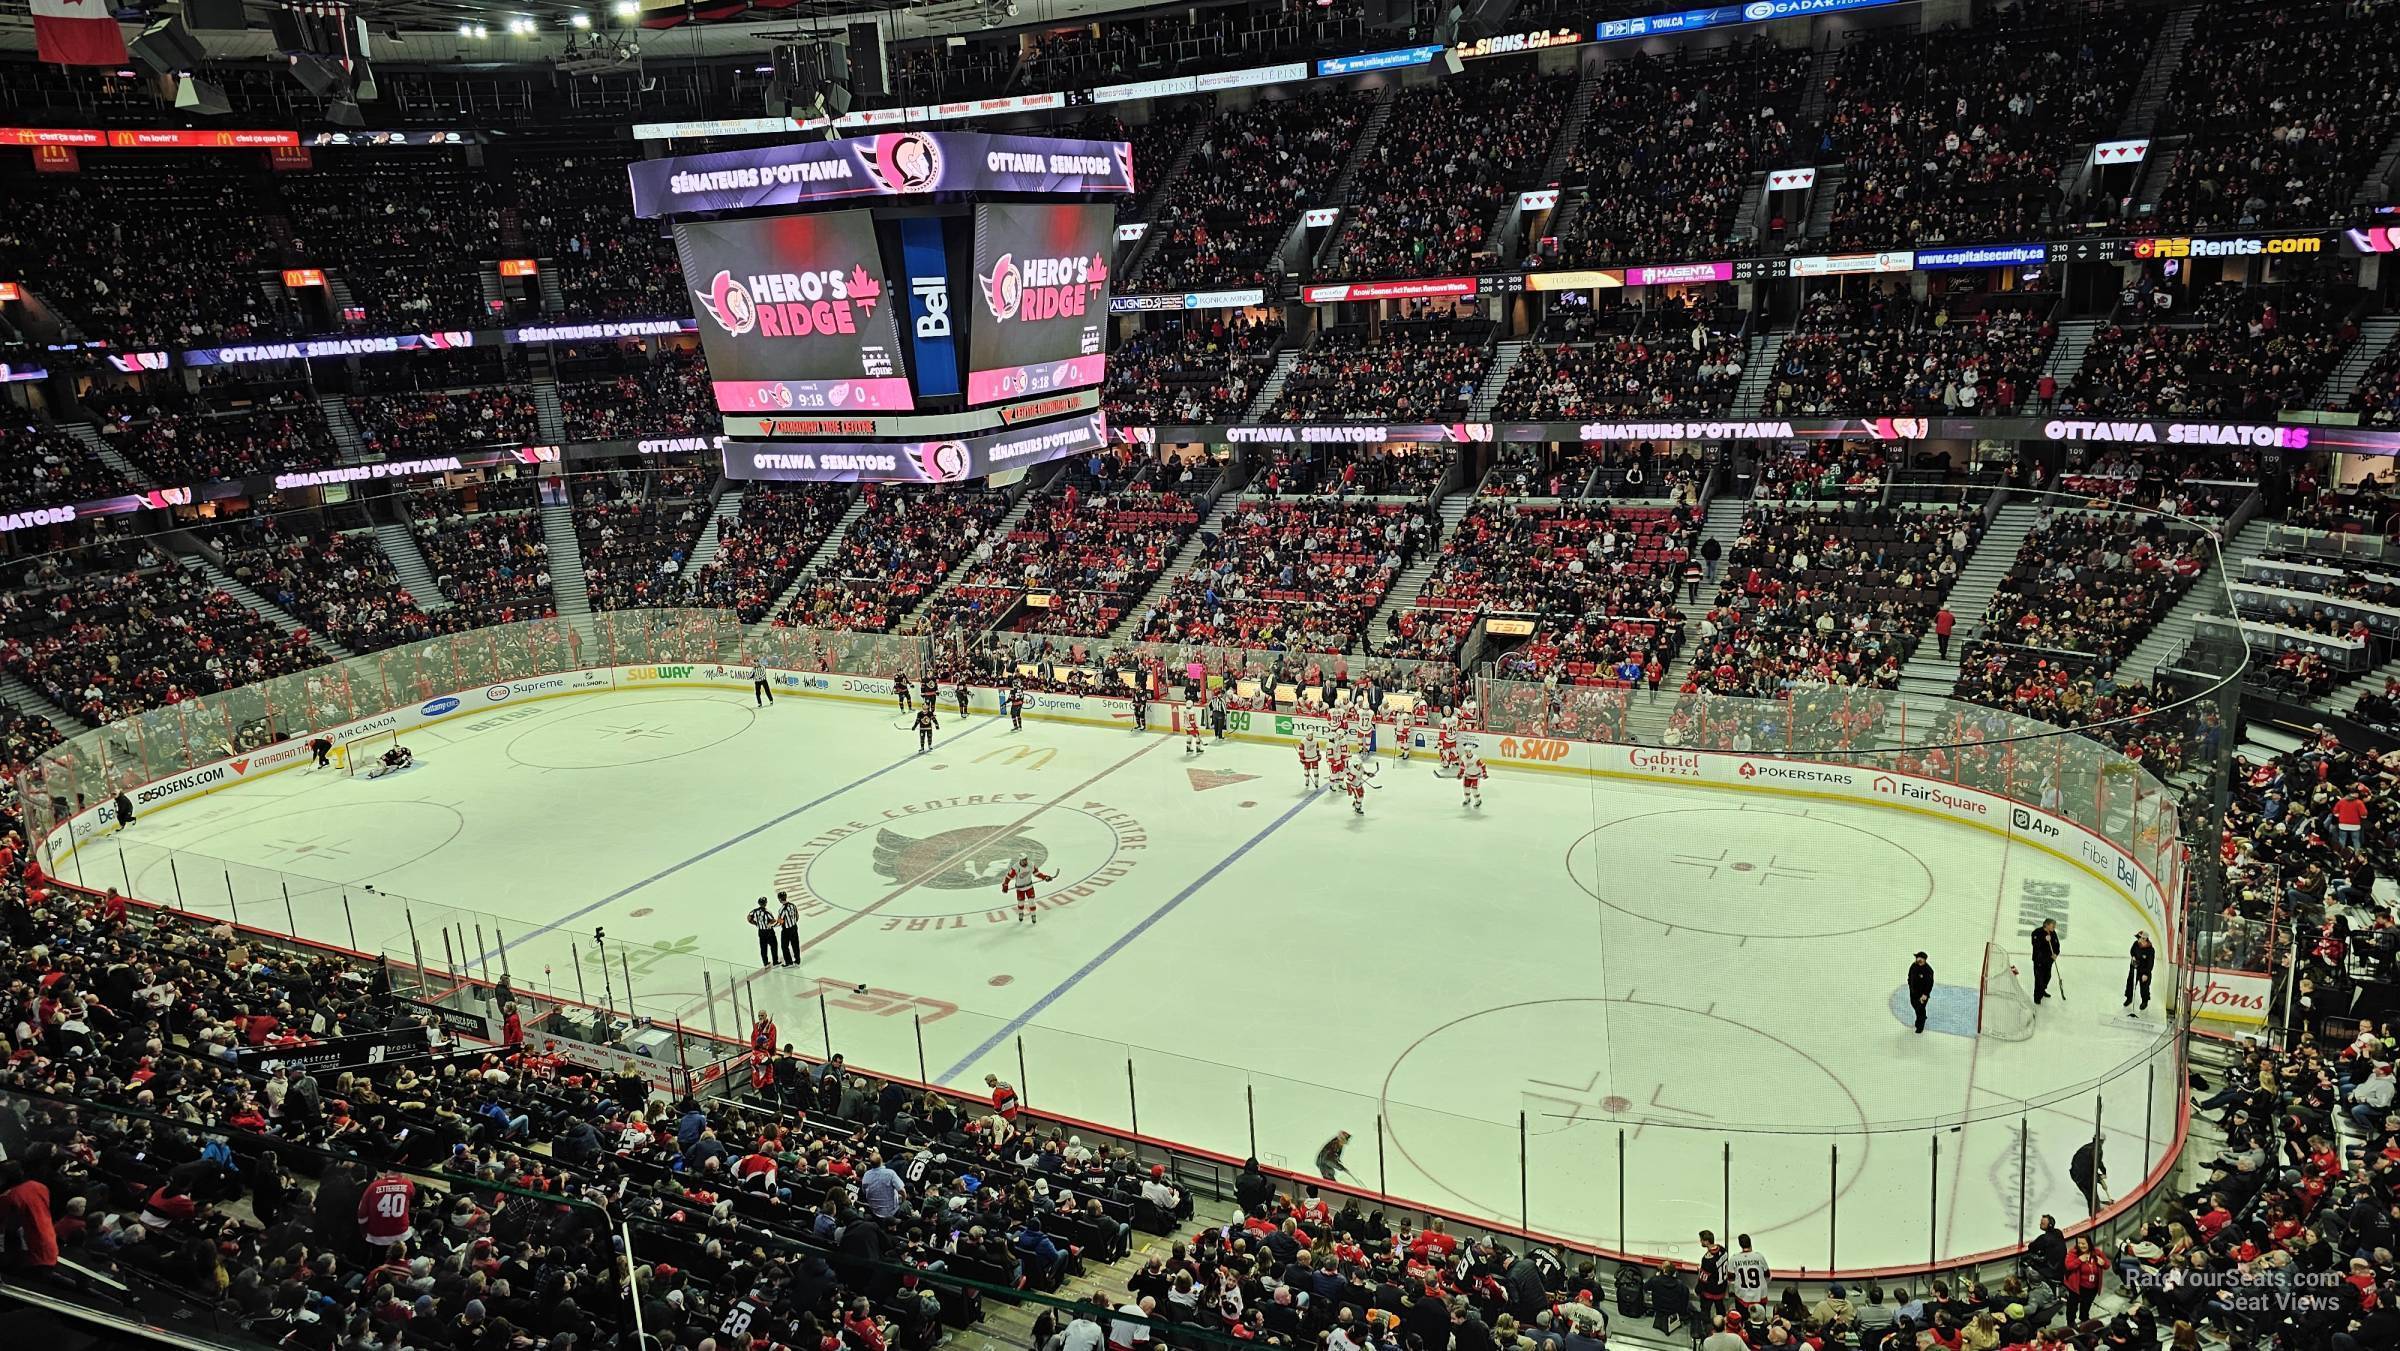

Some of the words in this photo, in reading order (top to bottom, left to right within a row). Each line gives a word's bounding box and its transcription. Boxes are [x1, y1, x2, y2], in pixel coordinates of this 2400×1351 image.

[1652, 17, 1684, 28] YOW.CA
[1475, 31, 1551, 55] SIGNS.CA
[987, 152, 1046, 173] OTTAWA
[1049, 155, 1111, 176] SENATORS
[670, 169, 758, 194] SÉNATEURS
[760, 159, 853, 189] D'OTTAWA
[2051, 254, 2067, 262] 210
[2099, 251, 2114, 260] 211
[2052, 244, 2068, 253] 310
[2099, 242, 2114, 251] 311
[1737, 262, 1752, 270] 309
[1771, 261, 1786, 269] 310
[1919, 248, 2045, 266] www.capitalsecurity.ca
[1022, 255, 1087, 287] HERO'S
[1657, 265, 1716, 278] MAGENTA
[1736, 271, 1751, 279] 209
[1771, 270, 1786, 278] 210
[749, 270, 848, 303] HERO'S
[1353, 289, 1370, 297] Know
[1393, 286, 1403, 294] Act
[1423, 283, 1447, 293] Remove
[1479, 278, 1493, 286] 308
[1508, 276, 1522, 284] 309
[1479, 286, 1493, 294] 208
[1508, 285, 1522, 293] 209
[911, 276, 951, 338] Bell
[1021, 284, 1085, 322] RIDGE
[1200, 297, 1229, 305] KONICA
[1230, 294, 1264, 304] MINOLTA
[755, 300, 857, 337] RIDGE
[518, 325, 603, 343] SÉNATEURS
[604, 320, 682, 338] D'OTTAWA
[220, 344, 304, 364] OTTAWA
[306, 337, 397, 357] SENATORS
[1070, 365, 1078, 380] 0
[1003, 376, 1011, 392] 0
[1031, 376, 1050, 391] 9:18
[758, 388, 768, 404] 0
[799, 393, 825, 408] 9:18
[855, 387, 866, 403] 0
[1225, 427, 1296, 443] OTTAWA
[1301, 426, 1388, 443] SENATORS
[1580, 422, 1686, 440] SÉNATEURS
[1686, 422, 1794, 439] D'OTTAWA
[2044, 420, 2157, 442] OTTAWA
[2167, 424, 2309, 449] SENATORS
[638, 438, 708, 454] OTTAWA
[989, 441, 1042, 467] SÉNATEURS
[1043, 430, 1090, 453] D'OTTAWA
[2069, 447, 2084, 456] 109
[753, 458, 816, 475] OTTAWA
[820, 457, 895, 476] SENATORS
[2264, 455, 2280, 463] 109
[276, 466, 371, 490] SÉNATEURS
[371, 455, 463, 478] D'OTTAWA
[1829, 466, 1841, 475] 28
[1493, 623, 1526, 633] TSN
[627, 665, 695, 682] SUBWAY
[489, 688, 508, 698] Esso
[513, 679, 563, 695] Supreme
[853, 680, 895, 695] Decisiv
[1038, 697, 1081, 711] Supreme
[338, 727, 352, 740] AIR
[353, 716, 397, 736] CANADA
[1361, 717, 1370, 727] 17
[1448, 726, 1457, 736] 45
[254, 744, 297, 769] CANADIAN
[1520, 738, 1570, 762] SKIP
[1629, 748, 1700, 769] Gabriel
[1651, 765, 1700, 777] PIZZA
[1759, 767, 1853, 785] POKERSTARS
[138, 767, 224, 805] 5050SENS.COM
[1901, 782, 1987, 815] FairSquare
[2082, 841, 2108, 869] Fibe
[2117, 857, 2138, 892] Bell
[906, 1160, 926, 1181] 18
[377, 1194, 406, 1218] 40
[1739, 1267, 1761, 1289] 19
[720, 1308, 751, 1338] 28
